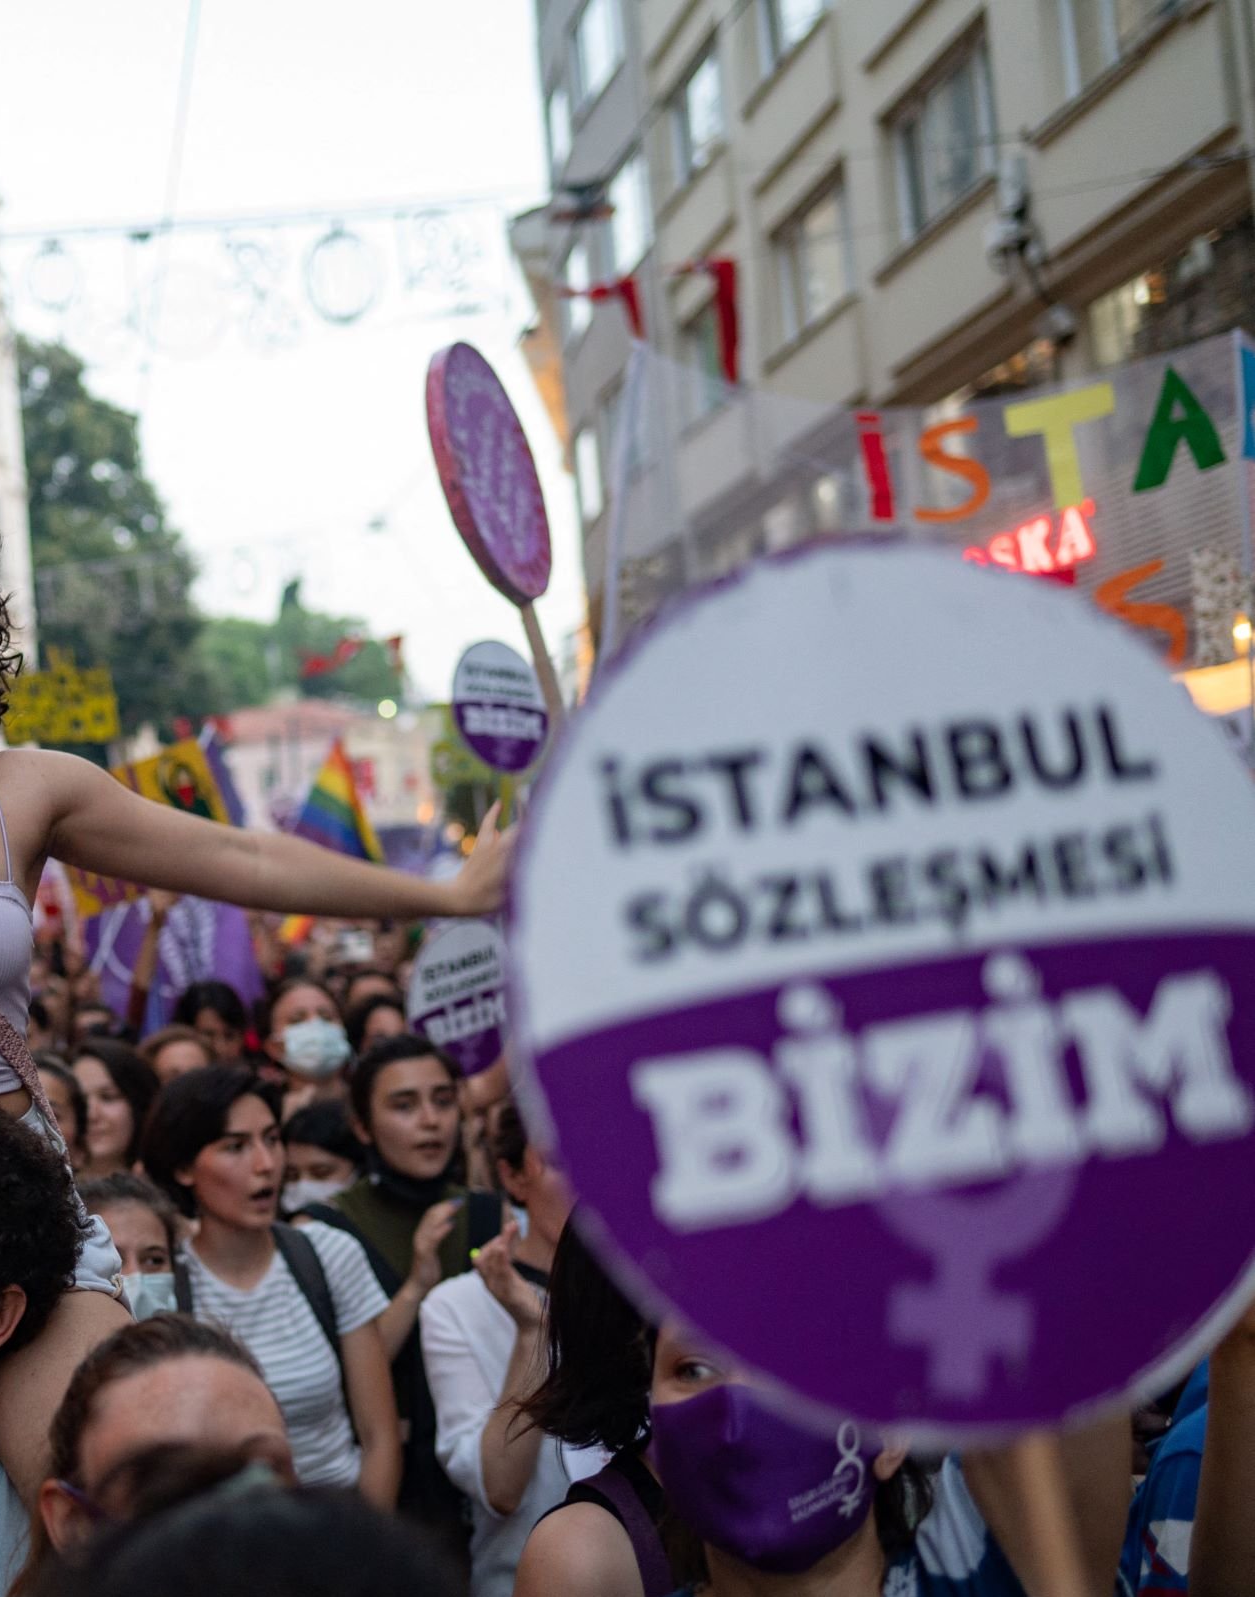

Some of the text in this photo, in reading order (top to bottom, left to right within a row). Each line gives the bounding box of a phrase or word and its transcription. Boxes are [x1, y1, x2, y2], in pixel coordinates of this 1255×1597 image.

[602, 702, 1158, 849] İSTANBUL
[624, 812, 1176, 964] SÖZLEŞMESİ
[629, 951, 1253, 1234] BİZİM
